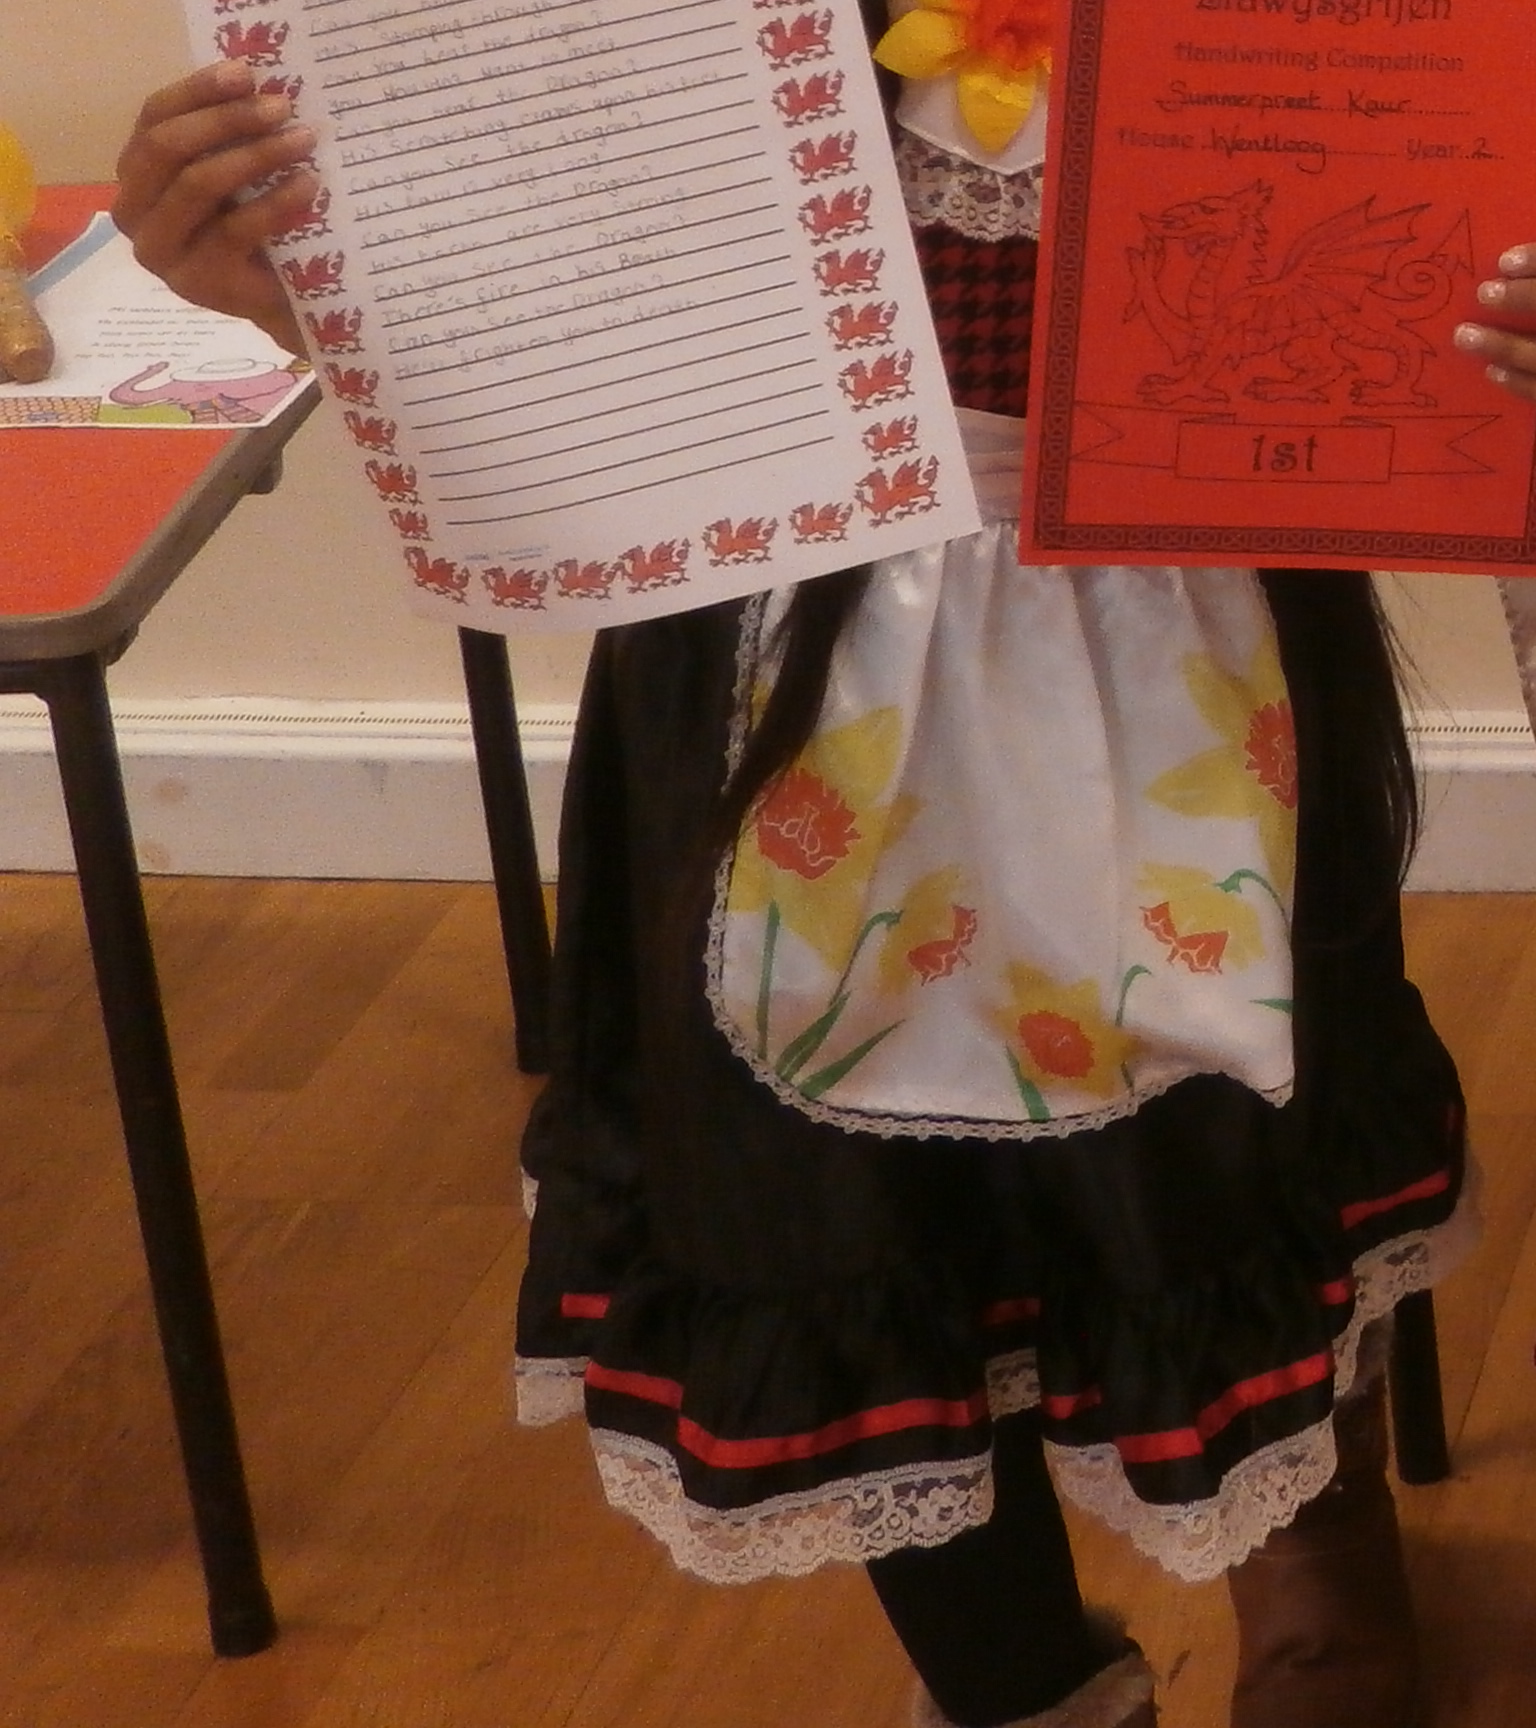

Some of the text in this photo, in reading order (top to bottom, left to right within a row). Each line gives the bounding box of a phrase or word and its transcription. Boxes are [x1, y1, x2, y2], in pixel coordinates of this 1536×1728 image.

[1173, 41, 1465, 74] Handwriting Competition
[1117, 122, 1496, 175] House Wentloog Year 2
[1252, 434, 1318, 472] 1st
